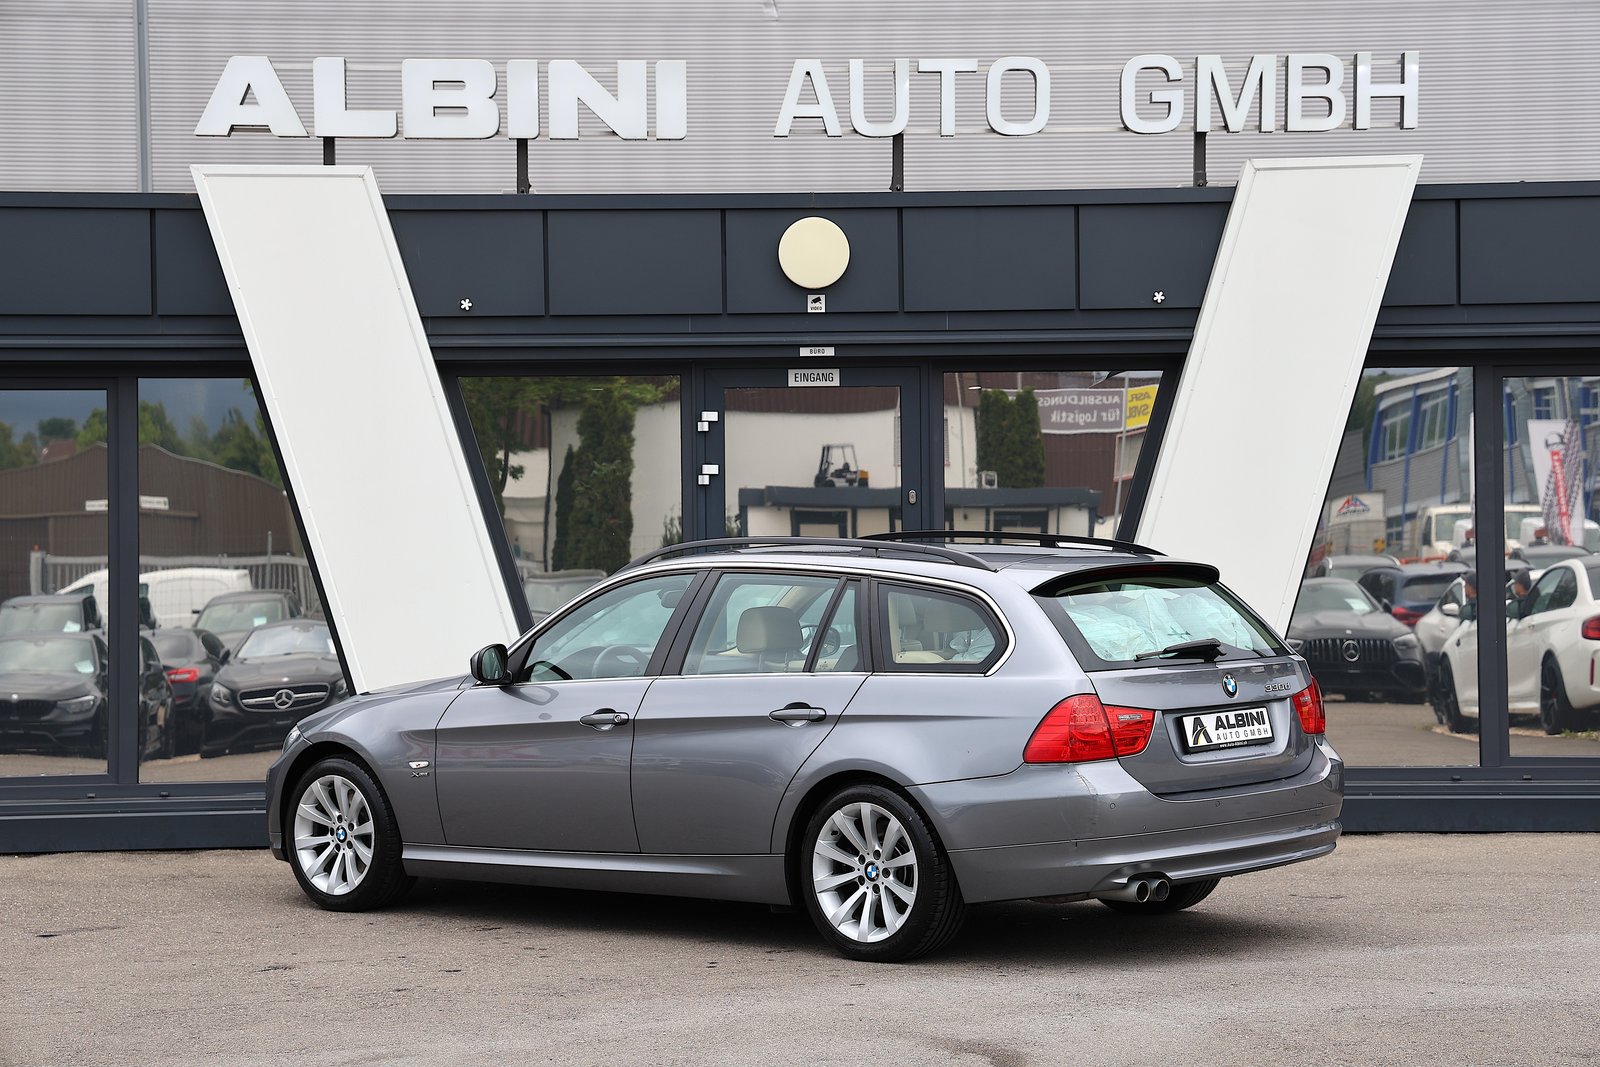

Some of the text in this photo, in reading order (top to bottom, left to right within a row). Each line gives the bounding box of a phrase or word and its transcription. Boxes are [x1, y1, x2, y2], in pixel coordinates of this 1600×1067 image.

[194, 50, 1420, 141] ALBINI AUTO GMBH
[794, 372, 834, 382] EINGANG
[1265, 682, 1292, 692] 330d
[1215, 711, 1266, 731] ALBINI
[1216, 728, 1269, 741] AUTO GMBH
